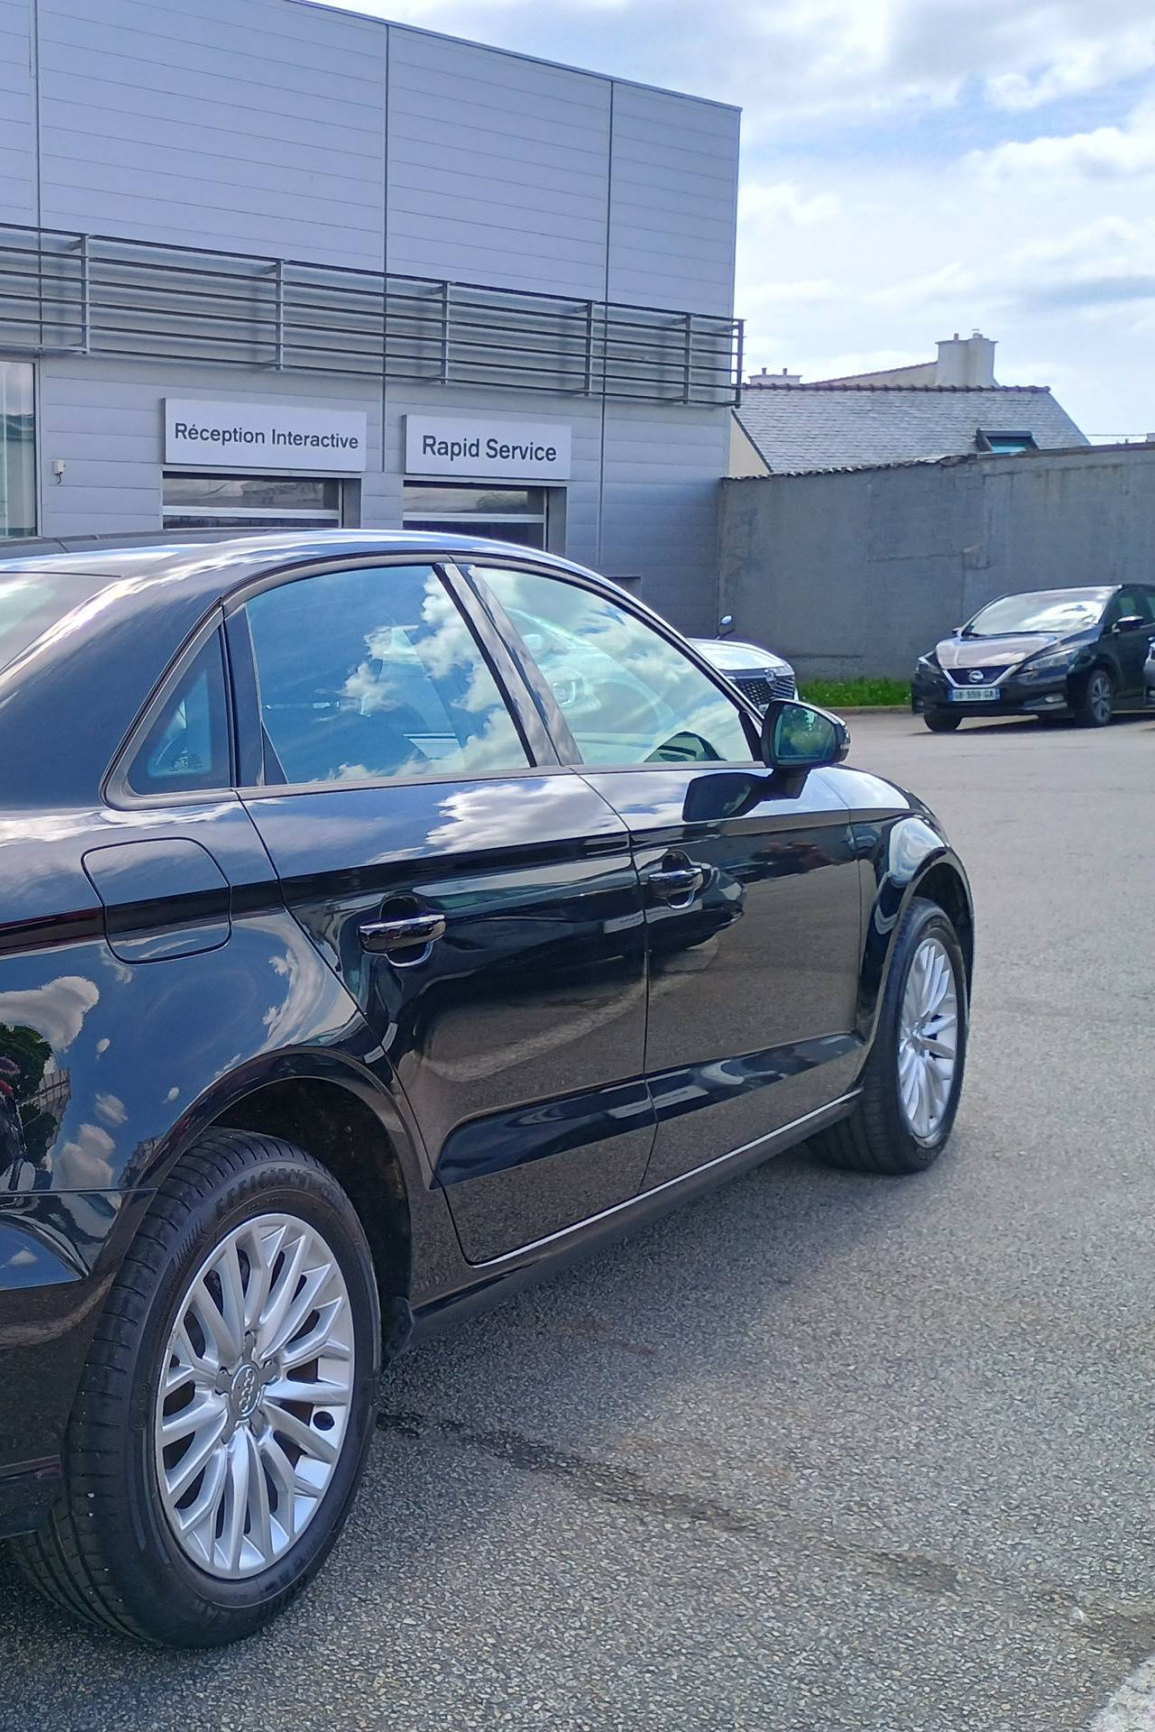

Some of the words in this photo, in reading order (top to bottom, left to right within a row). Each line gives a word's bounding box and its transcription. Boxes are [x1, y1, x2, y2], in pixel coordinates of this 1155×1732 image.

[175, 422, 265, 446] Réception
[271, 428, 359, 449] Interactive
[422, 435, 480, 461] Rapid
[485, 438, 557, 462] Service
